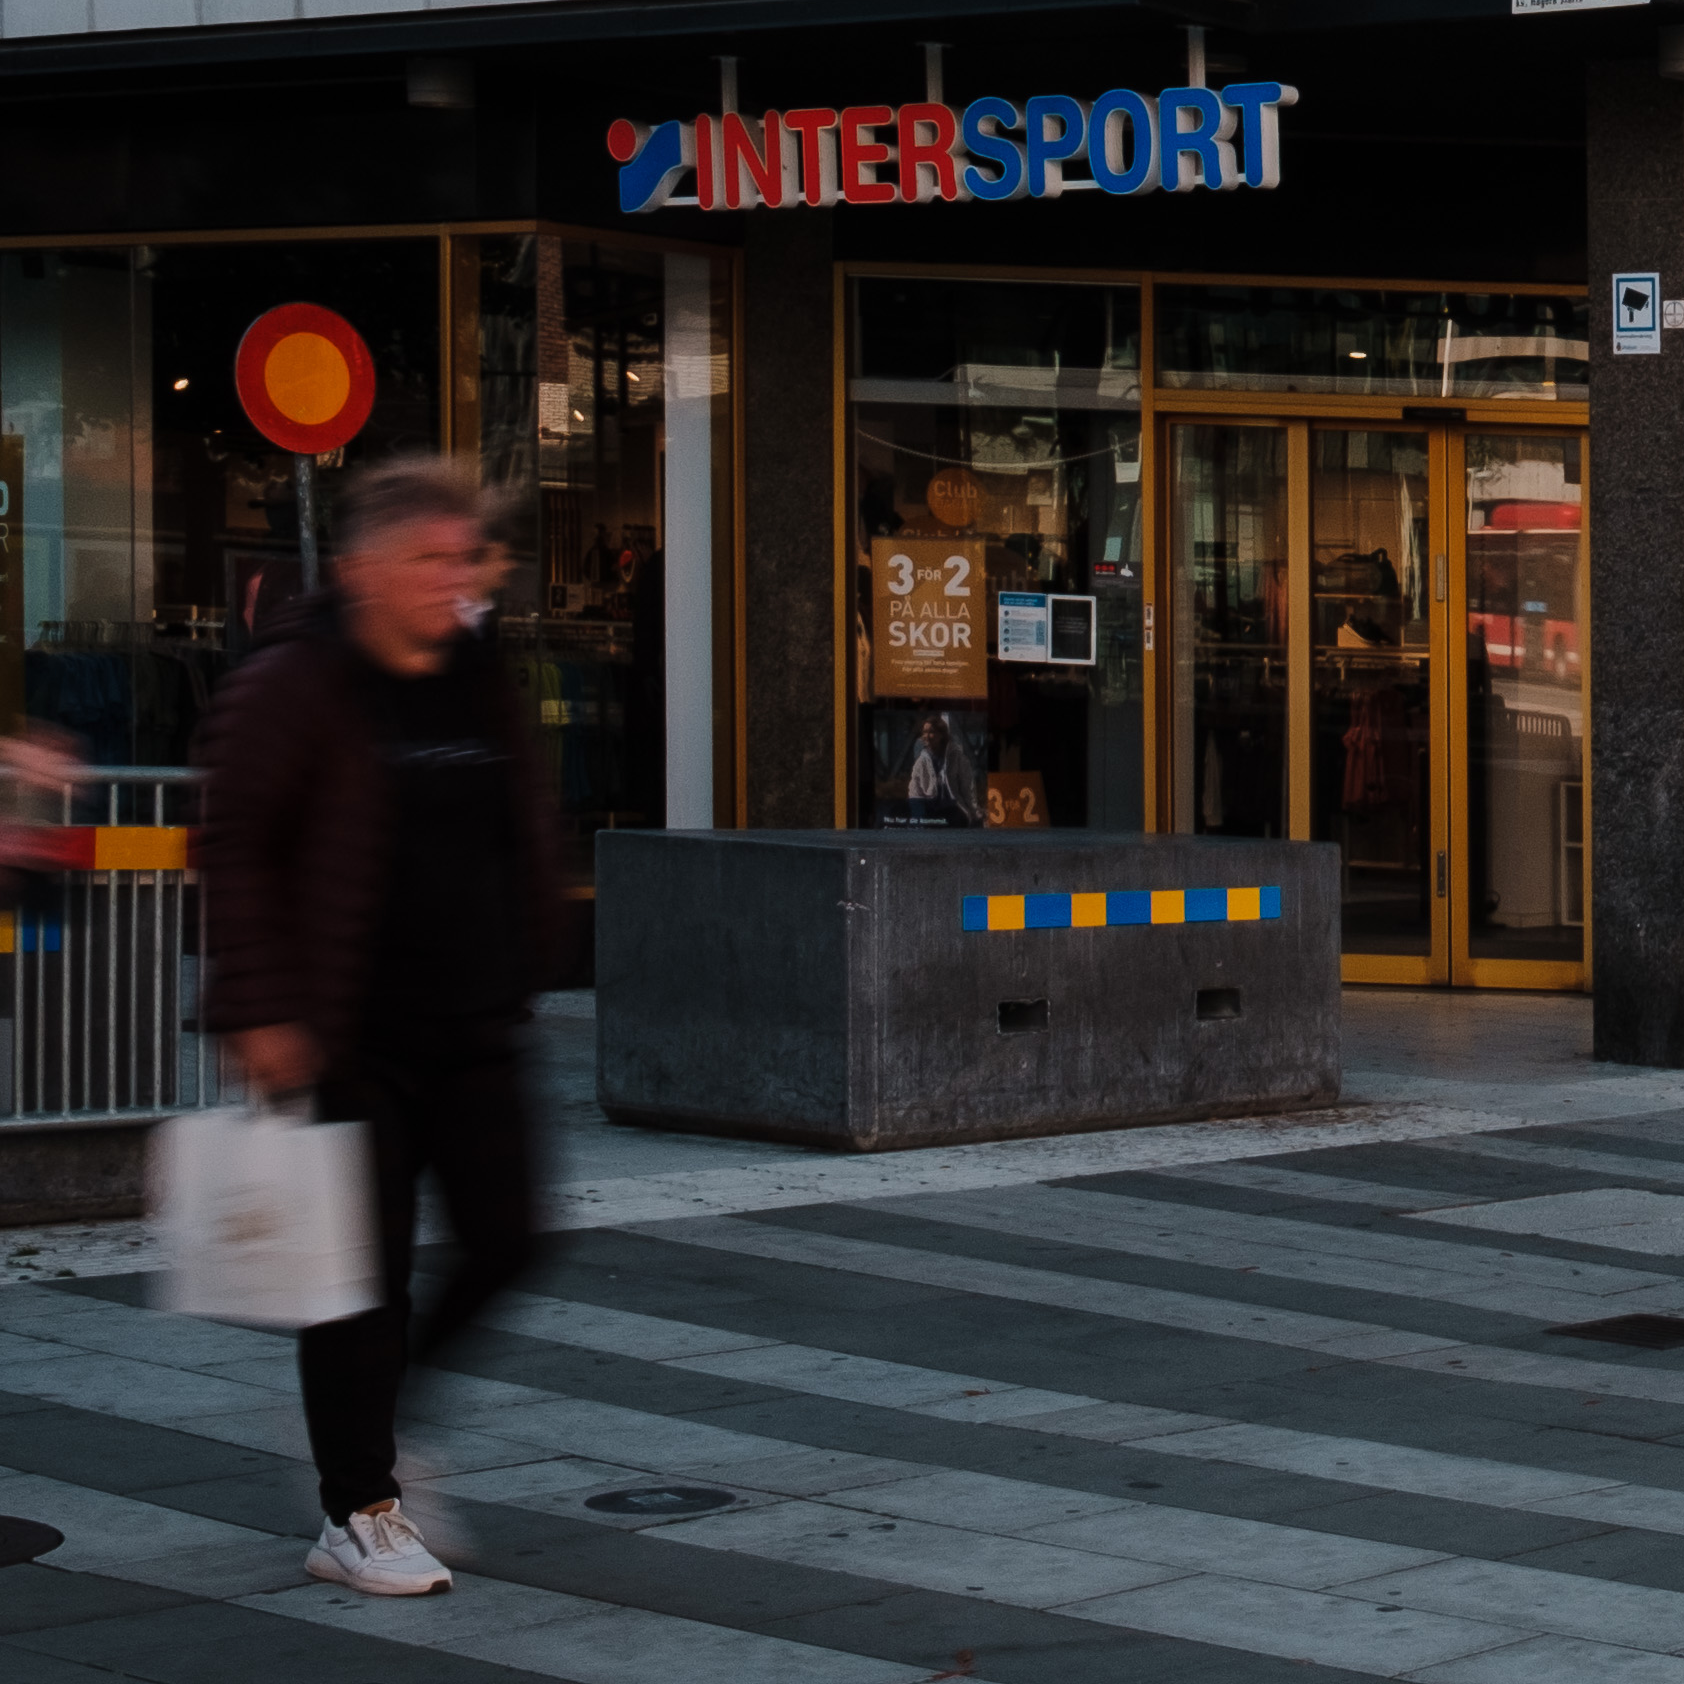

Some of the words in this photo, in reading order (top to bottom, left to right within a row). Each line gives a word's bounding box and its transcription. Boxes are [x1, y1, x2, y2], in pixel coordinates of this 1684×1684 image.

[697, 82, 1284, 210] INTERSPORT
[934, 480, 978, 499] Club
[887, 554, 915, 596] 3
[916, 566, 942, 582] FÖR
[943, 555, 971, 597] 2
[889, 595, 914, 618] PÅ
[919, 601, 971, 619] ALLA
[888, 620, 972, 649] SKOR
[988, 788, 1007, 824] 3
[1020, 787, 1040, 823] 2
